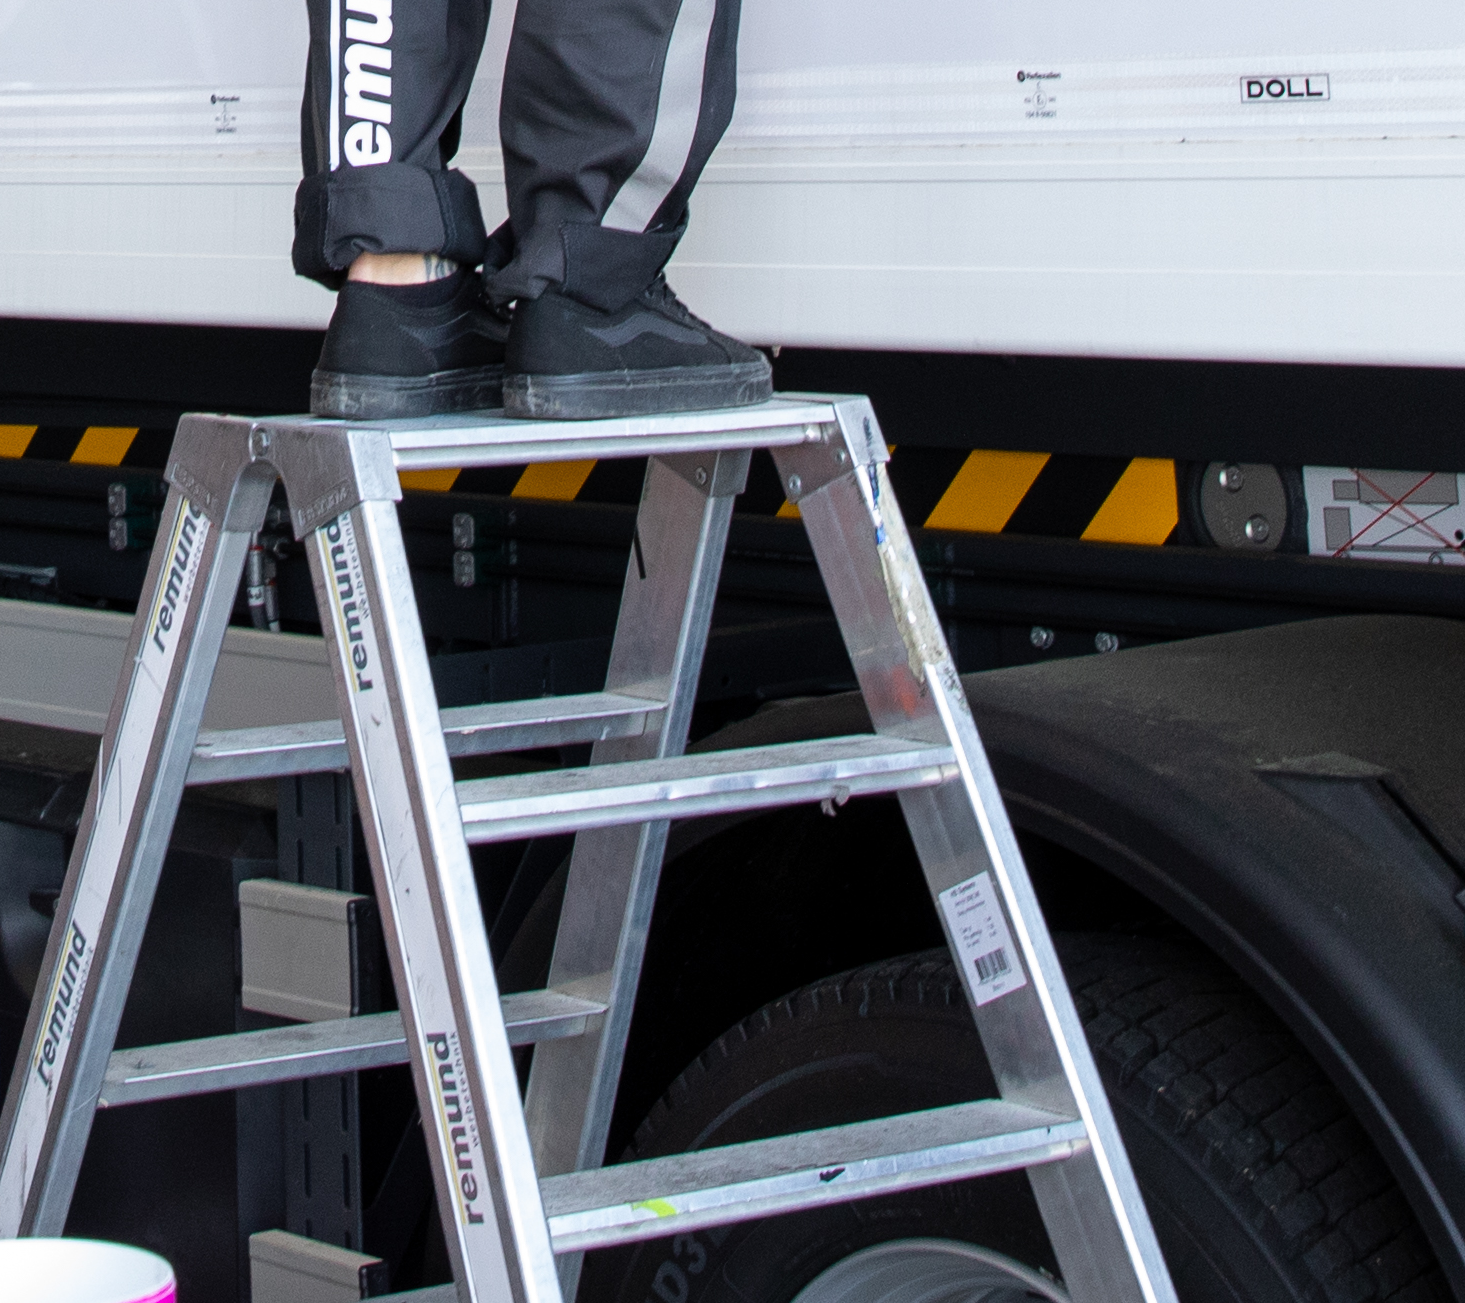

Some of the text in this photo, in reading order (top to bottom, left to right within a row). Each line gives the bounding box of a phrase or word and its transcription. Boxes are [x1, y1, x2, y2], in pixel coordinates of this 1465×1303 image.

[1247, 78, 1323, 98] DOLL
[37, 922, 89, 1086] remund
[427, 1031, 485, 1226] remund
